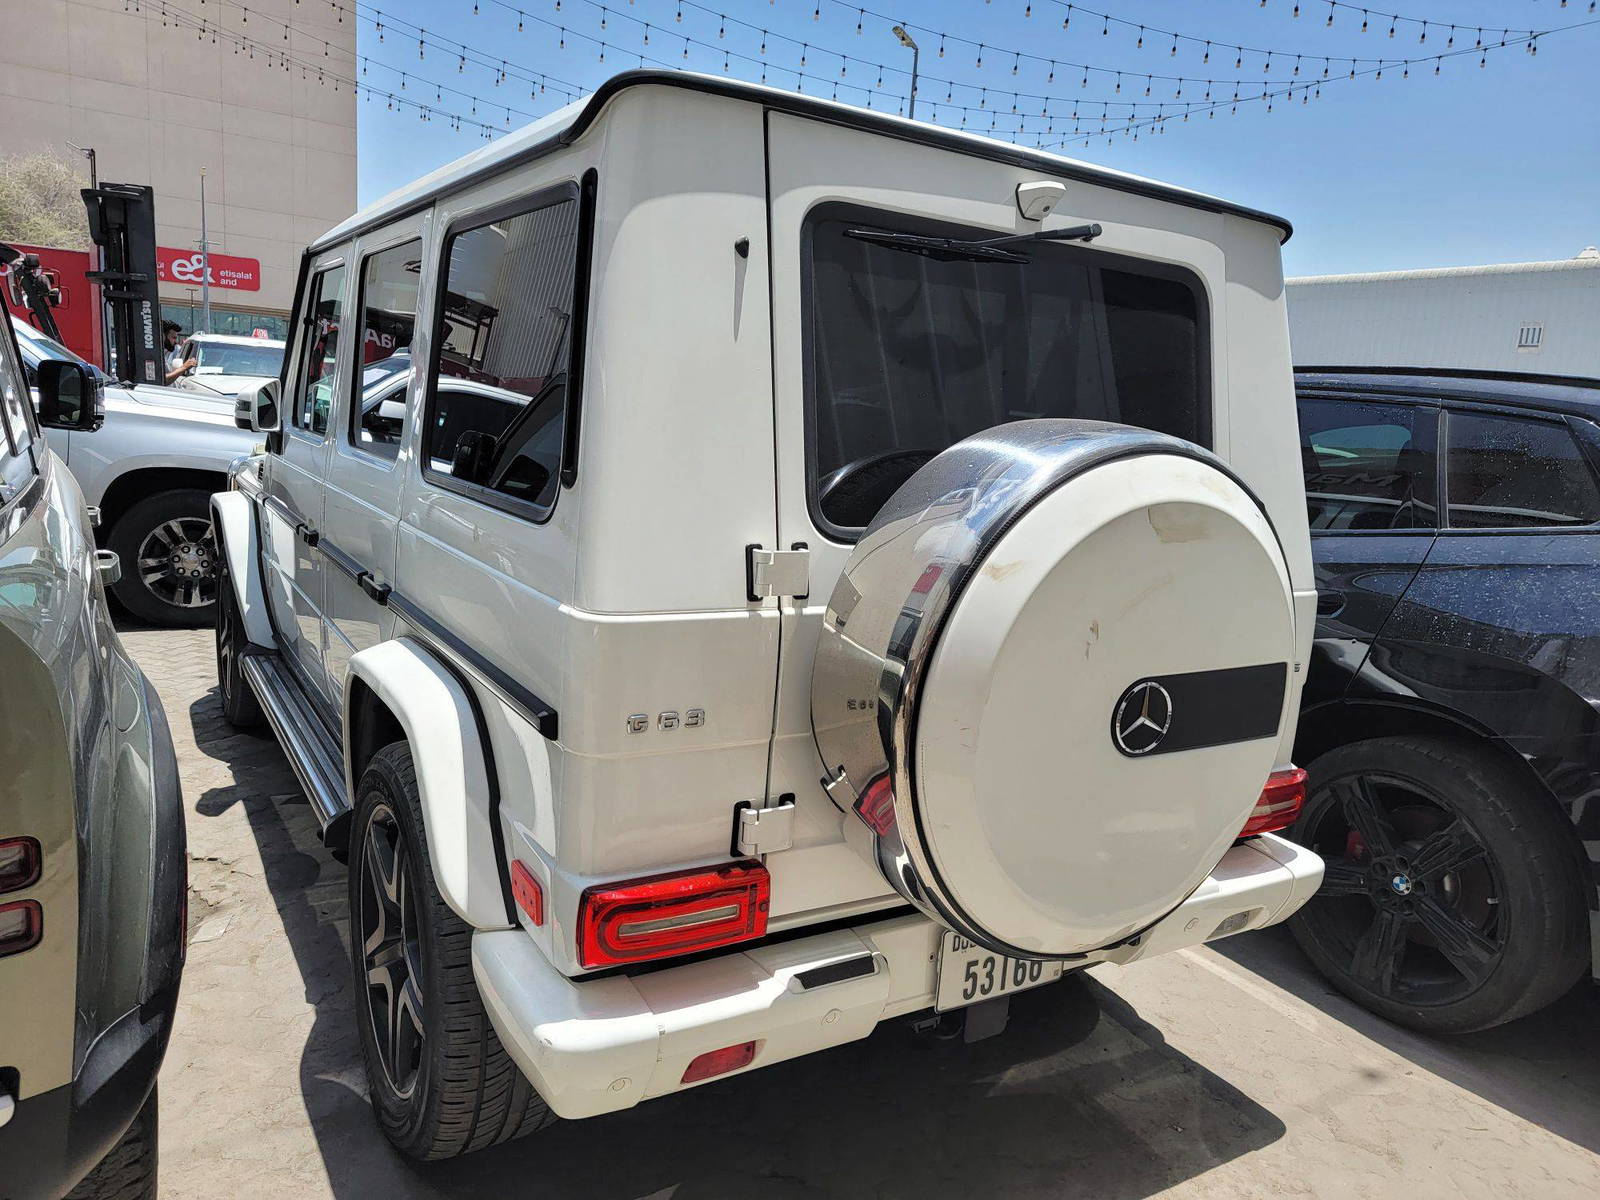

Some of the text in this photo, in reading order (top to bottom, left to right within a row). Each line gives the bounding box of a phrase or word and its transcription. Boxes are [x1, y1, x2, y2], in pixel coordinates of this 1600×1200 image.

[220, 270, 253, 280] etisalat
[220, 278, 237, 286] and
[141, 300, 154, 349] KOMATSU
